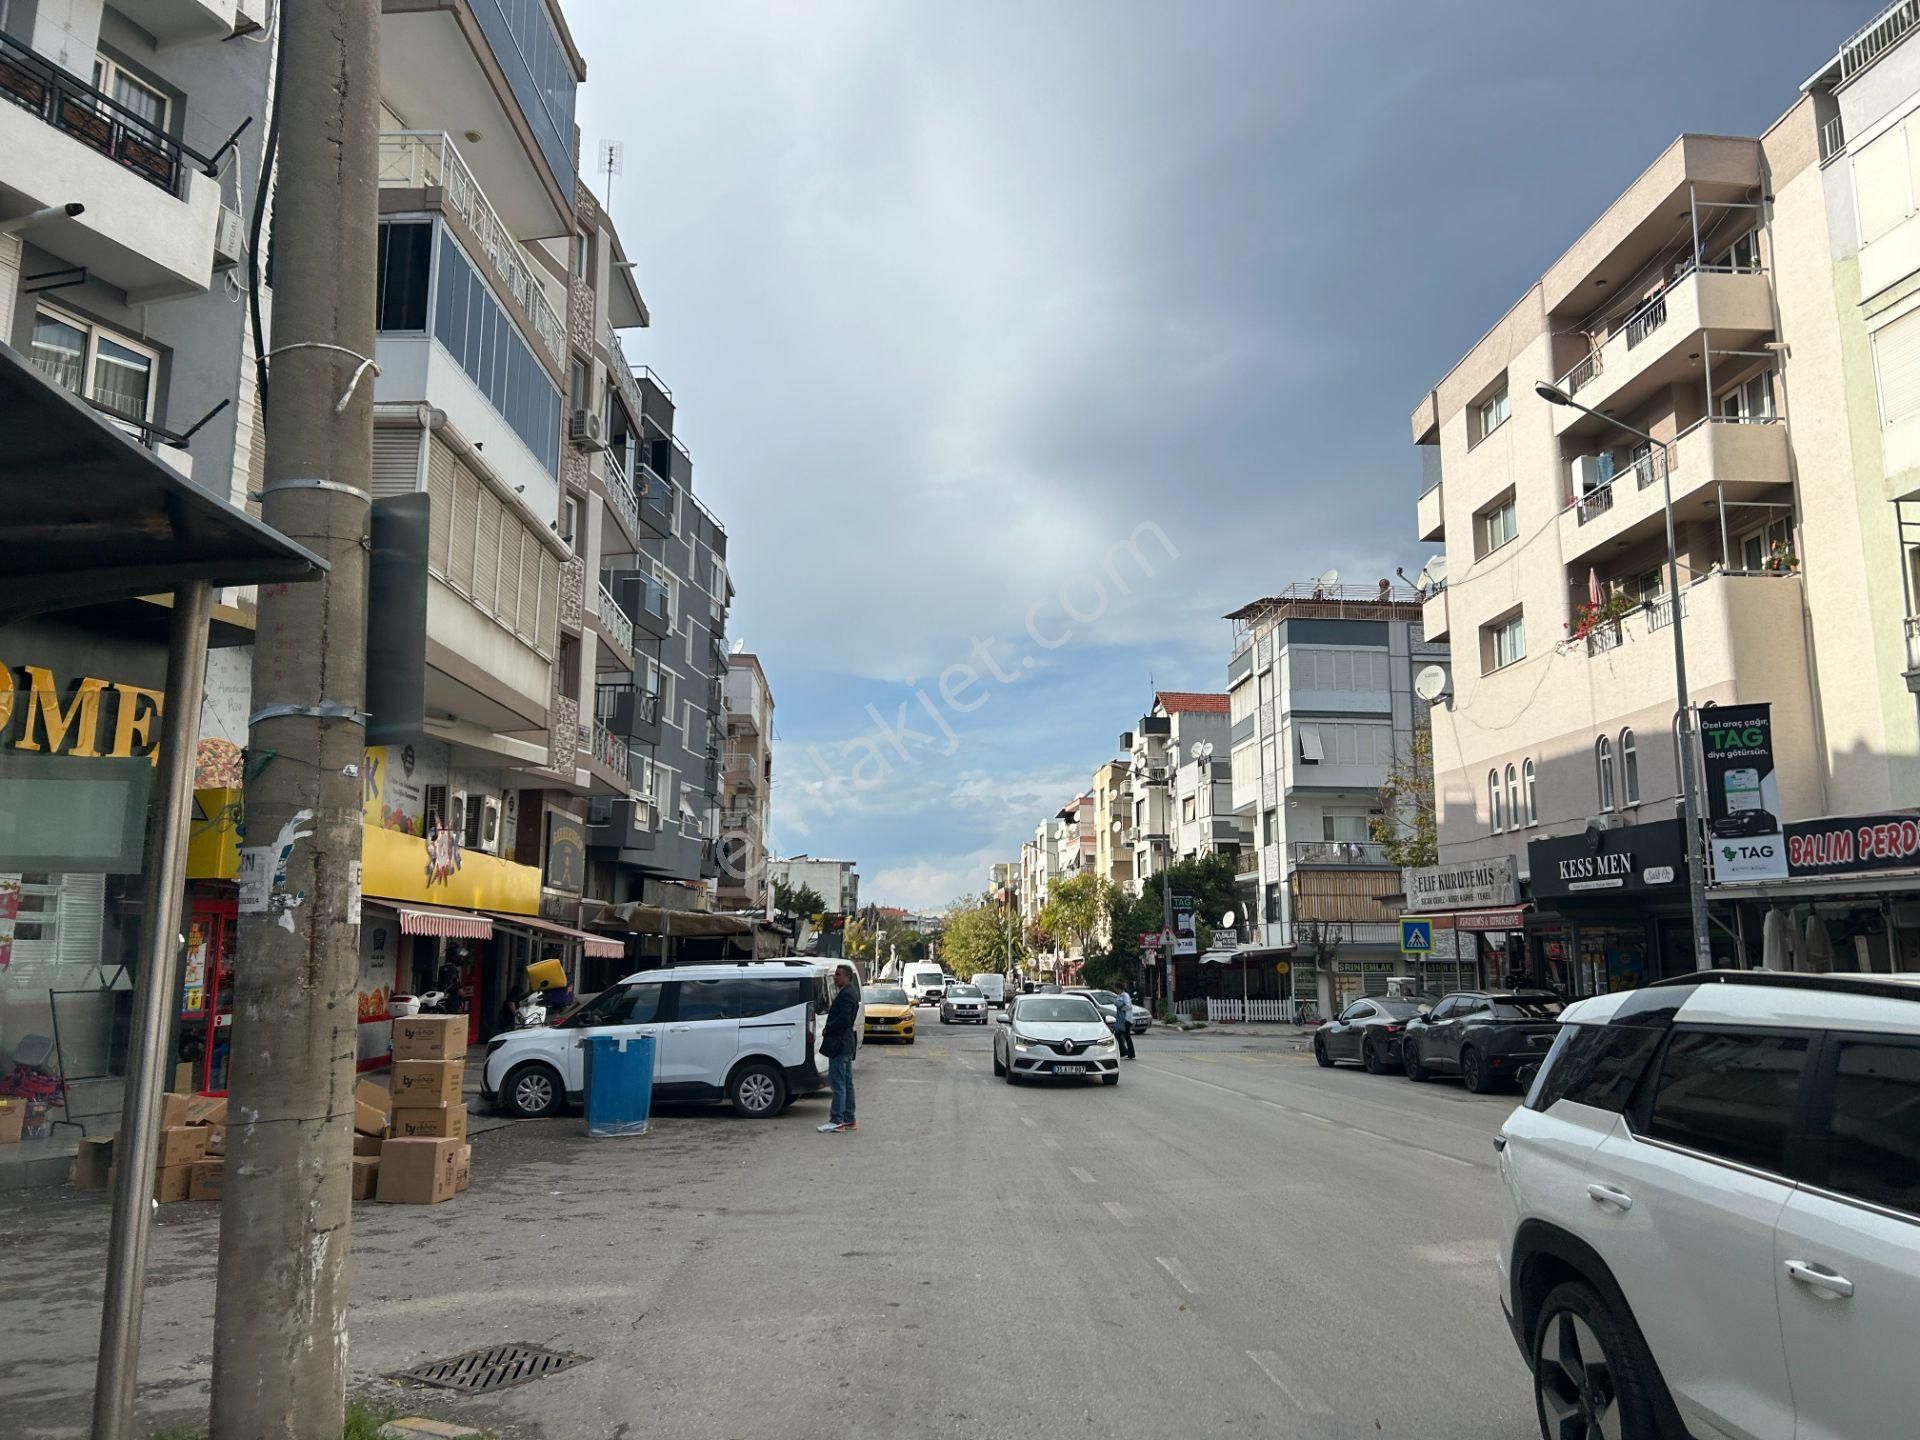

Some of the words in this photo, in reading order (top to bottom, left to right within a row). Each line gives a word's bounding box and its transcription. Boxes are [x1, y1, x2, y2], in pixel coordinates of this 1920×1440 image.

[1702, 721, 1721, 729] Özel
[1723, 720, 1743, 729] araç
[1708, 728, 1763, 750] TAG
[1707, 751, 1725, 760] diye
[1727, 748, 1769, 759] götürsün.
[1789, 829, 1855, 868] BALIM
[1858, 820, 1920, 861] PERD
[1738, 846, 1774, 859] TAG
[1558, 857, 1593, 880] KESS
[1597, 852, 1632, 876] MEN
[1364, 963, 1393, 972] EMLAK
[405, 1027, 415, 1039] by
[403, 1075, 414, 1088] by
[405, 1123, 416, 1136] by
